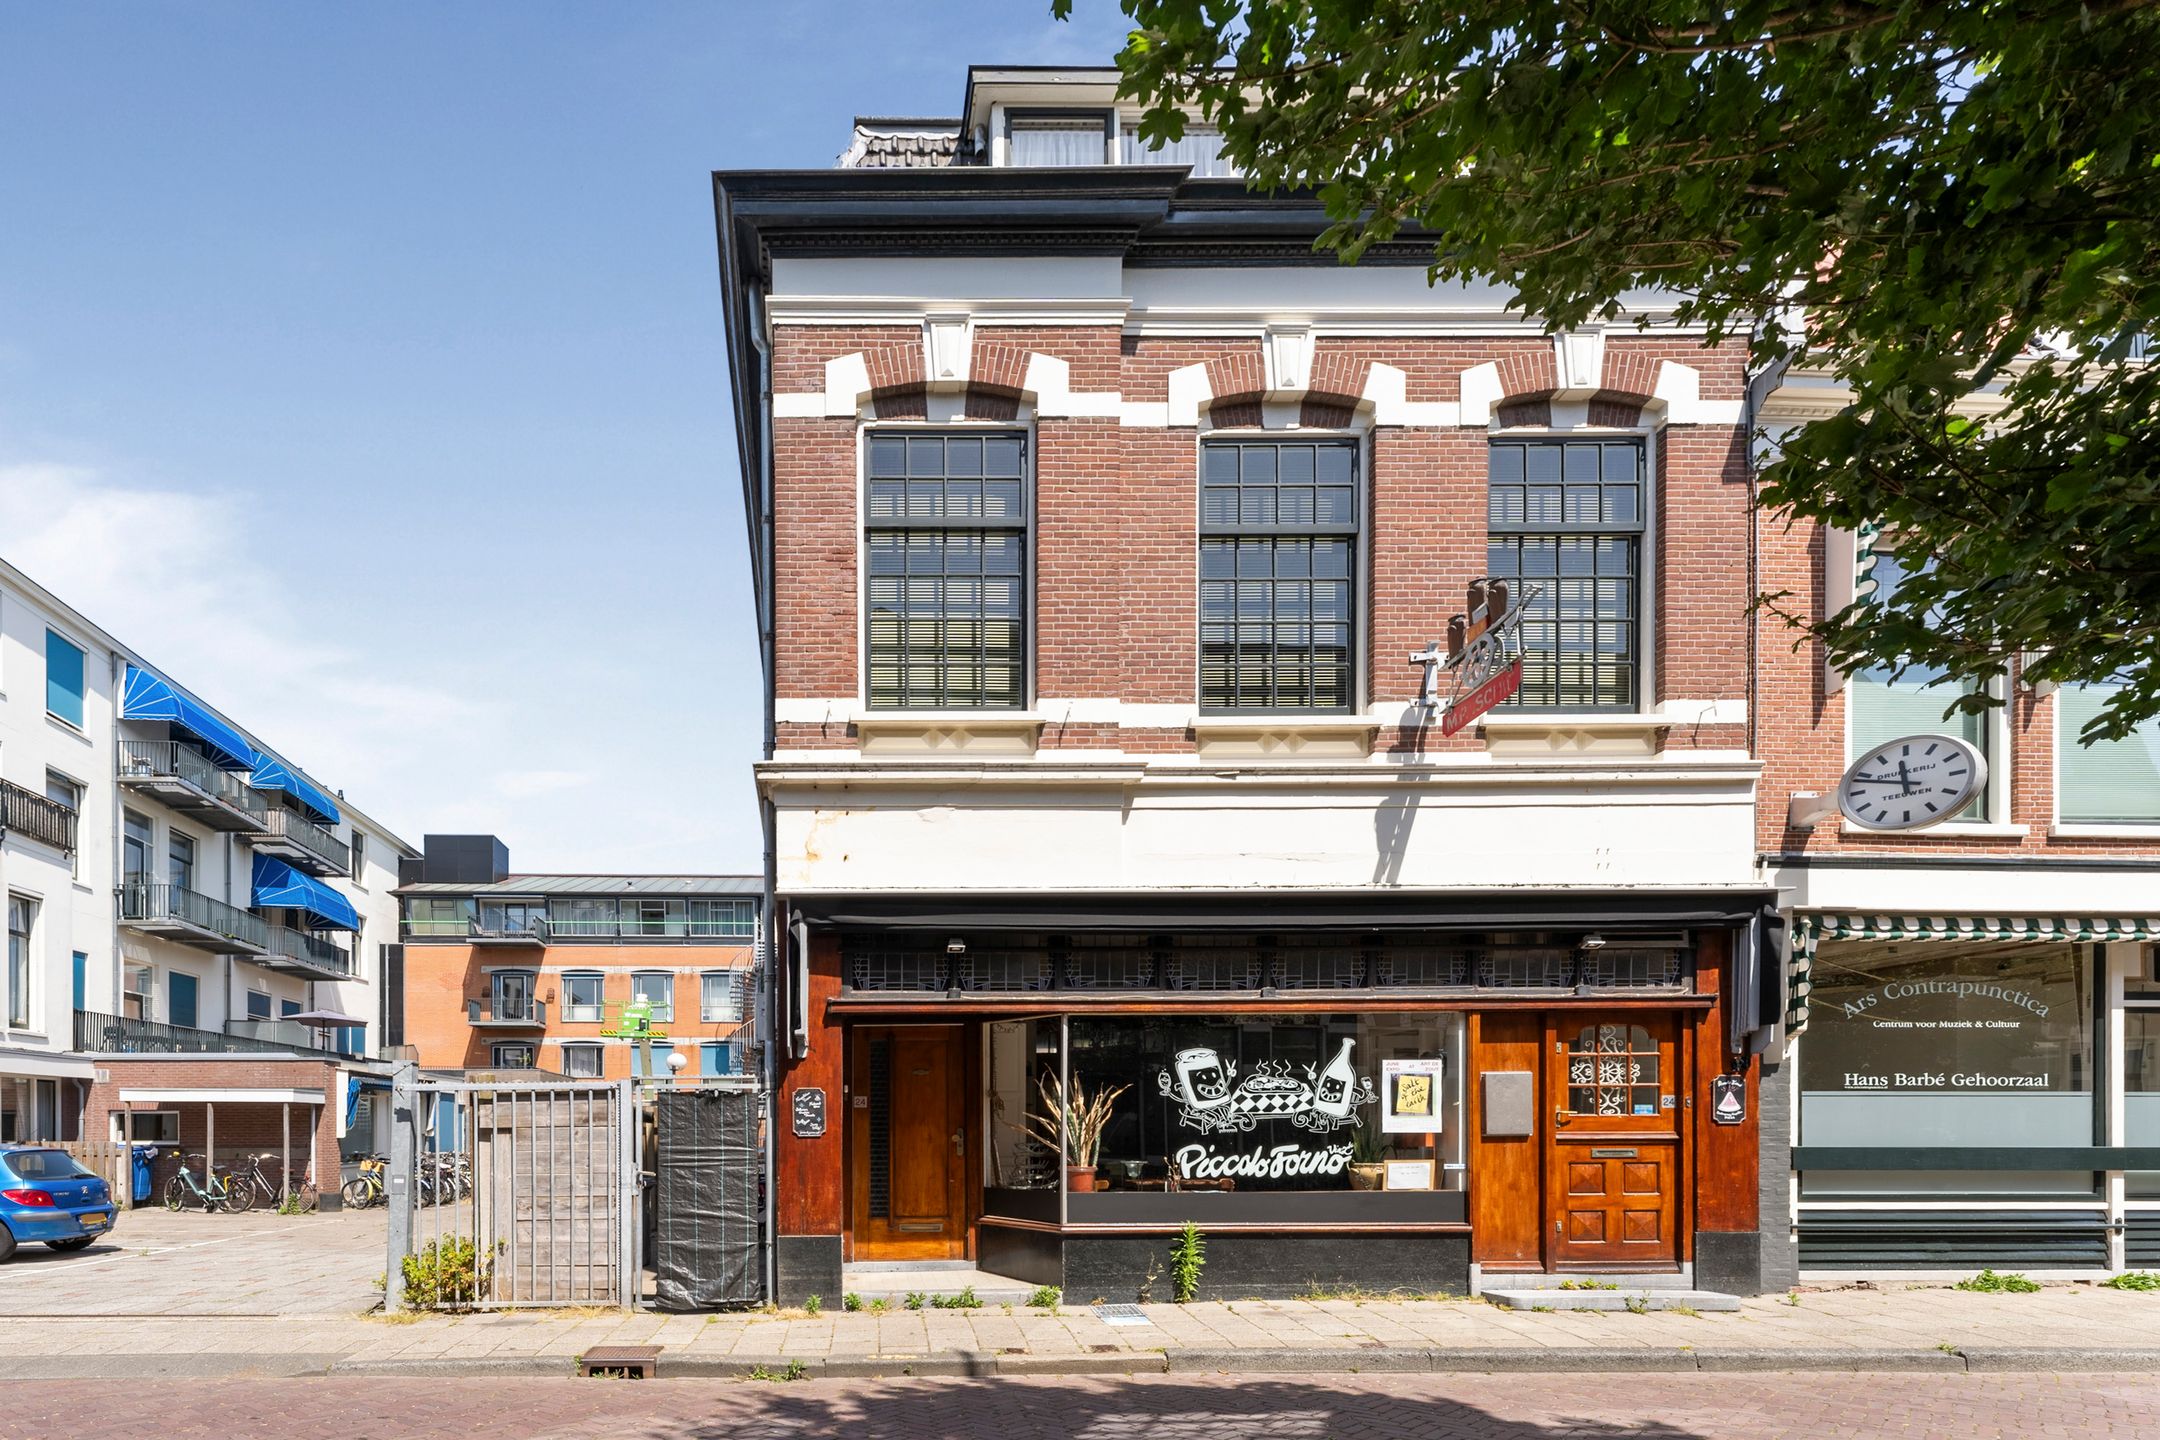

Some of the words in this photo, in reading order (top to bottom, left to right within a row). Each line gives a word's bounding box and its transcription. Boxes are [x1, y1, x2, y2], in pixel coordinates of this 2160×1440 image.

[1877, 763, 1936, 780] DRUKERIJ
[1842, 993, 1878, 1019] Ars
[1883, 980, 2049, 1018] Contrapunctica
[1873, 1020, 1913, 1028] Centrum
[1939, 1020, 1973, 1028] Muziek
[1974, 1020, 1984, 1028] &
[1985, 1020, 2021, 1028] Cultuur
[1844, 1072, 1889, 1086] Hans
[1894, 1072, 1945, 1086] Barbé
[1951, 1073, 2049, 1087] Gehoorzaal
[1663, 1097, 1676, 1107] 24
[1176, 1143, 1270, 1179] Piccolo
[1270, 1144, 1352, 1178] Forno
